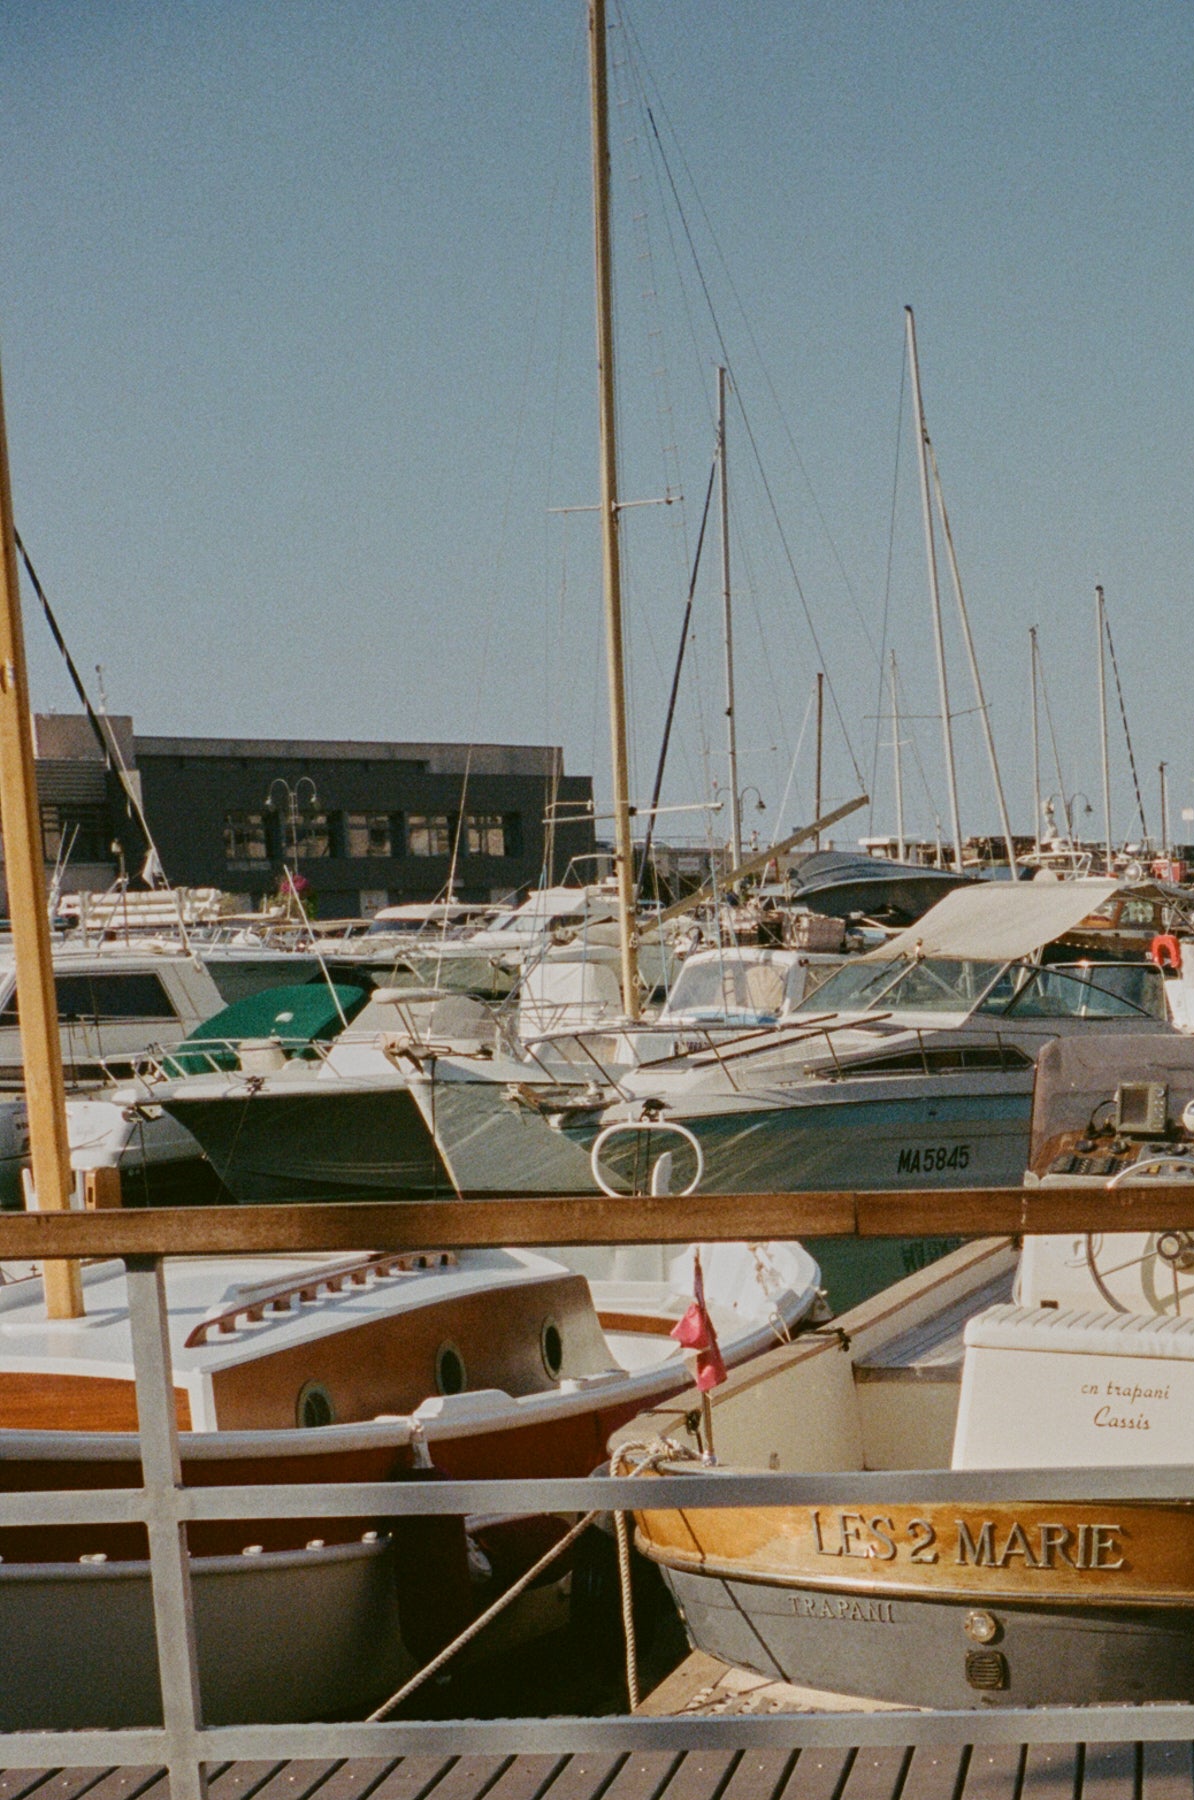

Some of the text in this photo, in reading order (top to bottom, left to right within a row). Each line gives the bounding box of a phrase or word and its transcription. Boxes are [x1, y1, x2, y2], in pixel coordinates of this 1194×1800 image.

[897, 1144, 971, 1174] MA5845
[1106, 1381, 1170, 1404] trapani
[1094, 1405, 1151, 1430] Cassis
[809, 1509, 1127, 1570] LES 2 MARIE
[788, 1594, 896, 1623] TRAPANI
